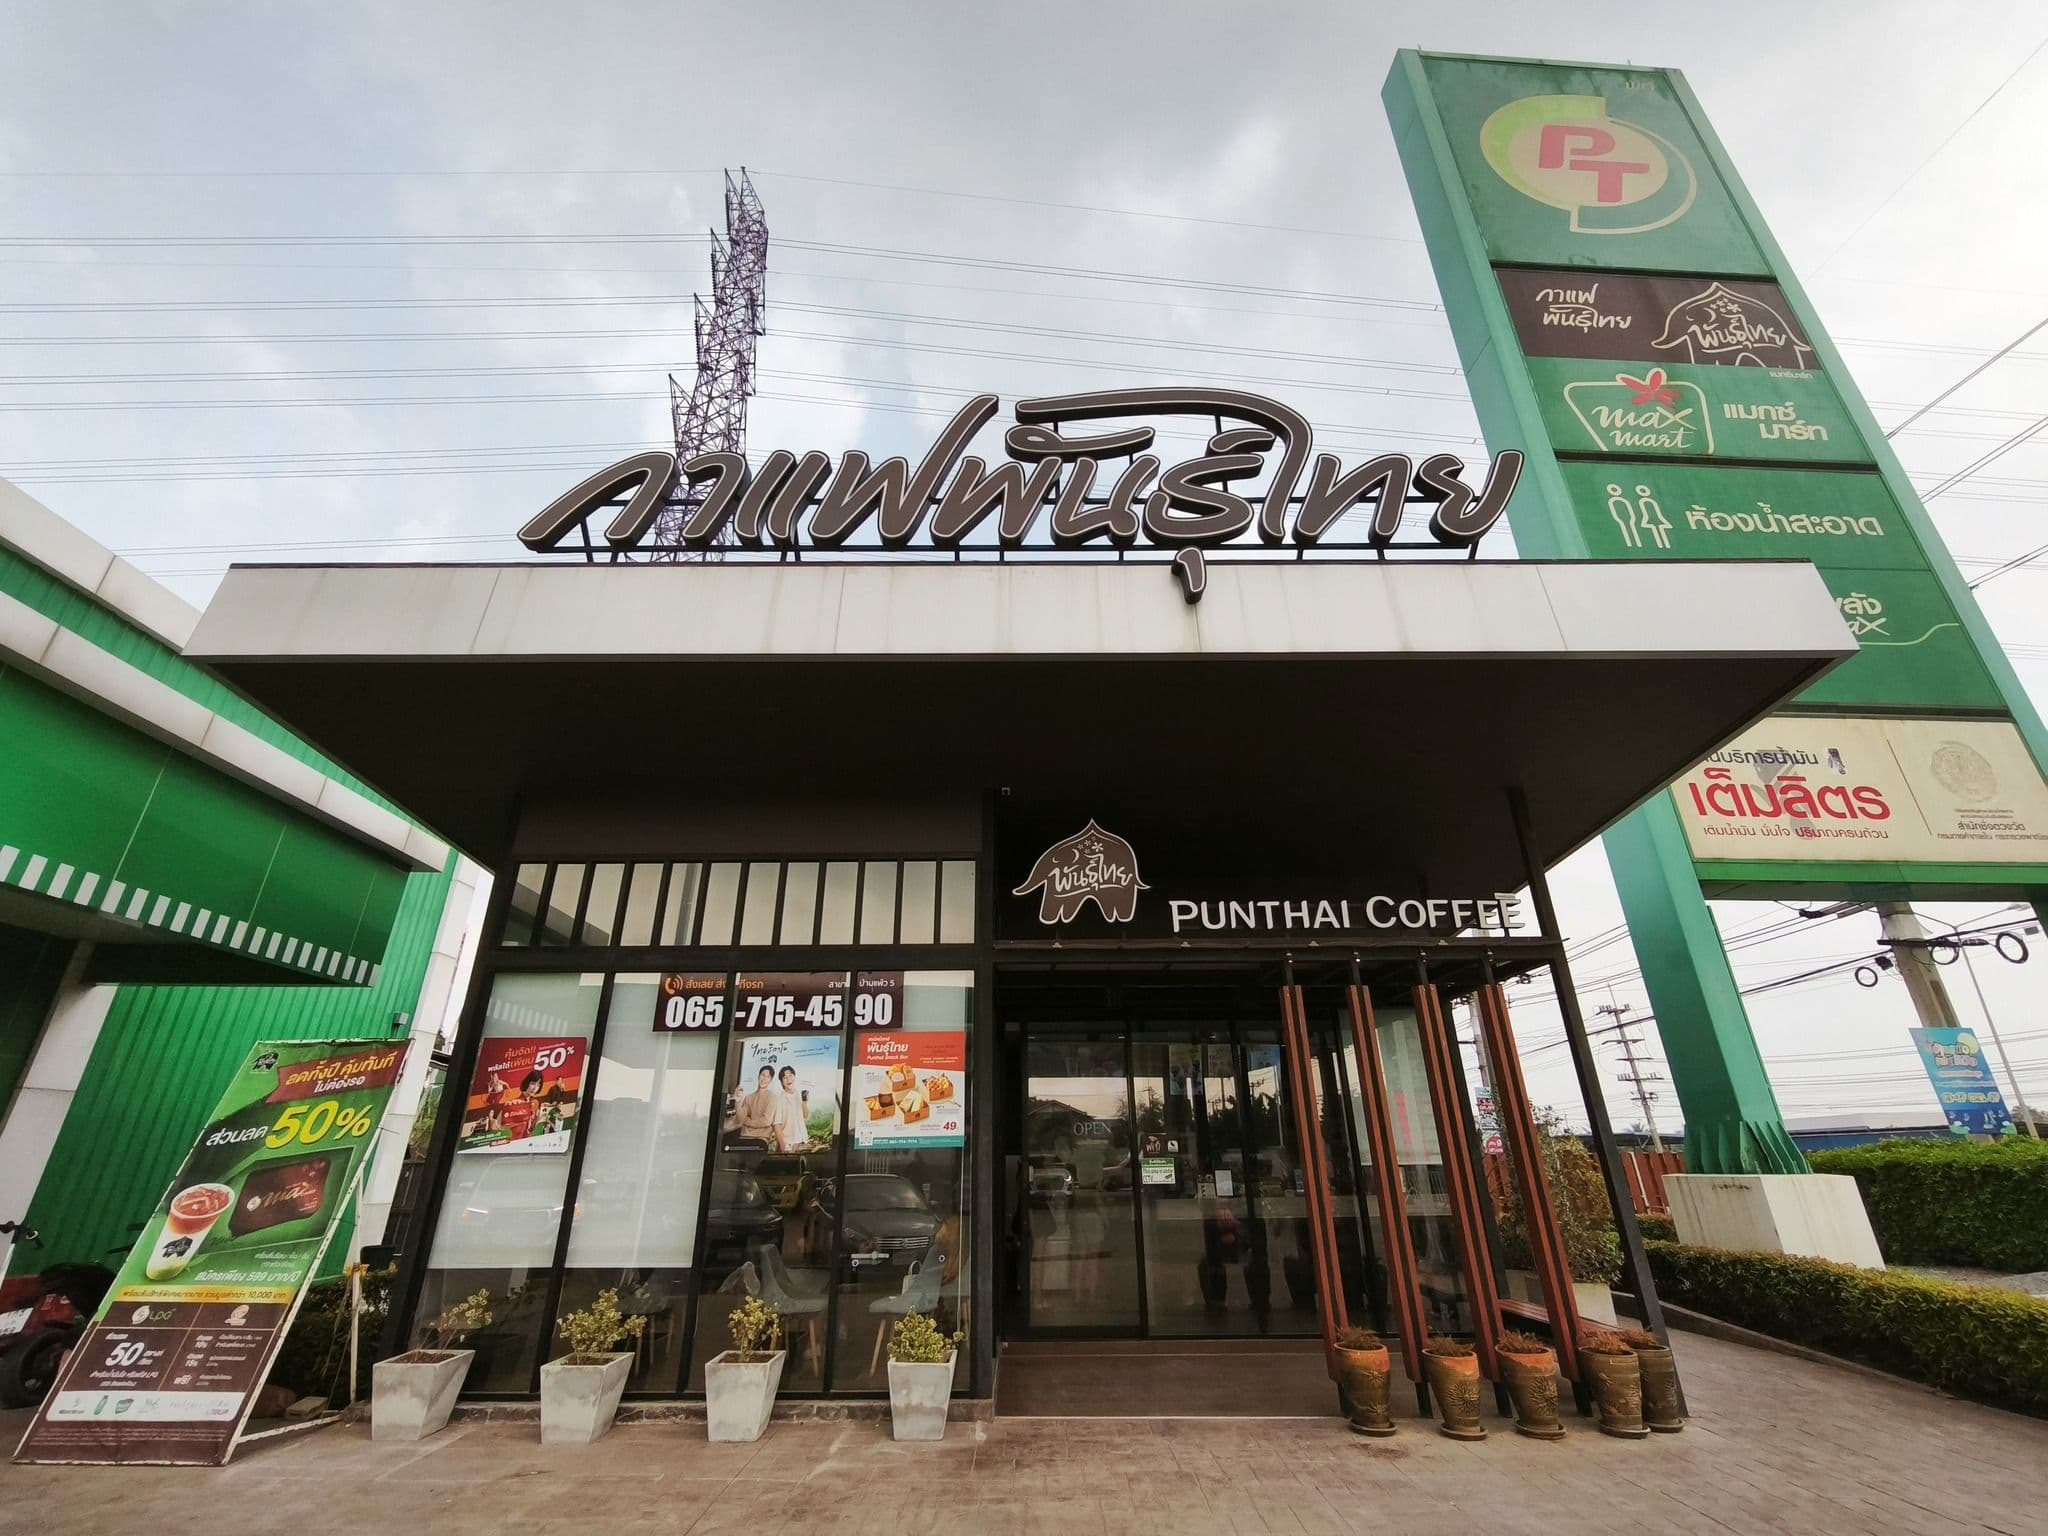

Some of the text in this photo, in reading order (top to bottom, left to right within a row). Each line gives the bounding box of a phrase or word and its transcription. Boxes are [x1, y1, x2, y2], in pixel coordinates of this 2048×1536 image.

[1538, 125, 1650, 202] PT
[1536, 283, 1599, 302] กาแฟ
[1543, 304, 1631, 333] พันธุ์ไทย
[1689, 314, 1786, 349] พันธุ์ไทย
[1724, 402, 1796, 421] แมกซ์
[1609, 427, 1694, 448] mart
[1759, 420, 1828, 441] มาร์ท
[1685, 502, 1885, 536] ห้องน้ำสะอาด
[1848, 616, 1890, 636] ax
[1705, 746, 1819, 765] นบริการน้ำมัน
[1688, 767, 1891, 820] เต็มลิตร
[1703, 823, 1756, 837] เติมน้ำมัน
[1048, 853, 1134, 892] พันธุ์ไทย
[1168, 899, 1351, 933] PUNTHAI
[889, 979, 895, 987] 5
[206, 1100, 373, 1149] ส่วนลด 50%
[105, 1342, 145, 1367] 50
